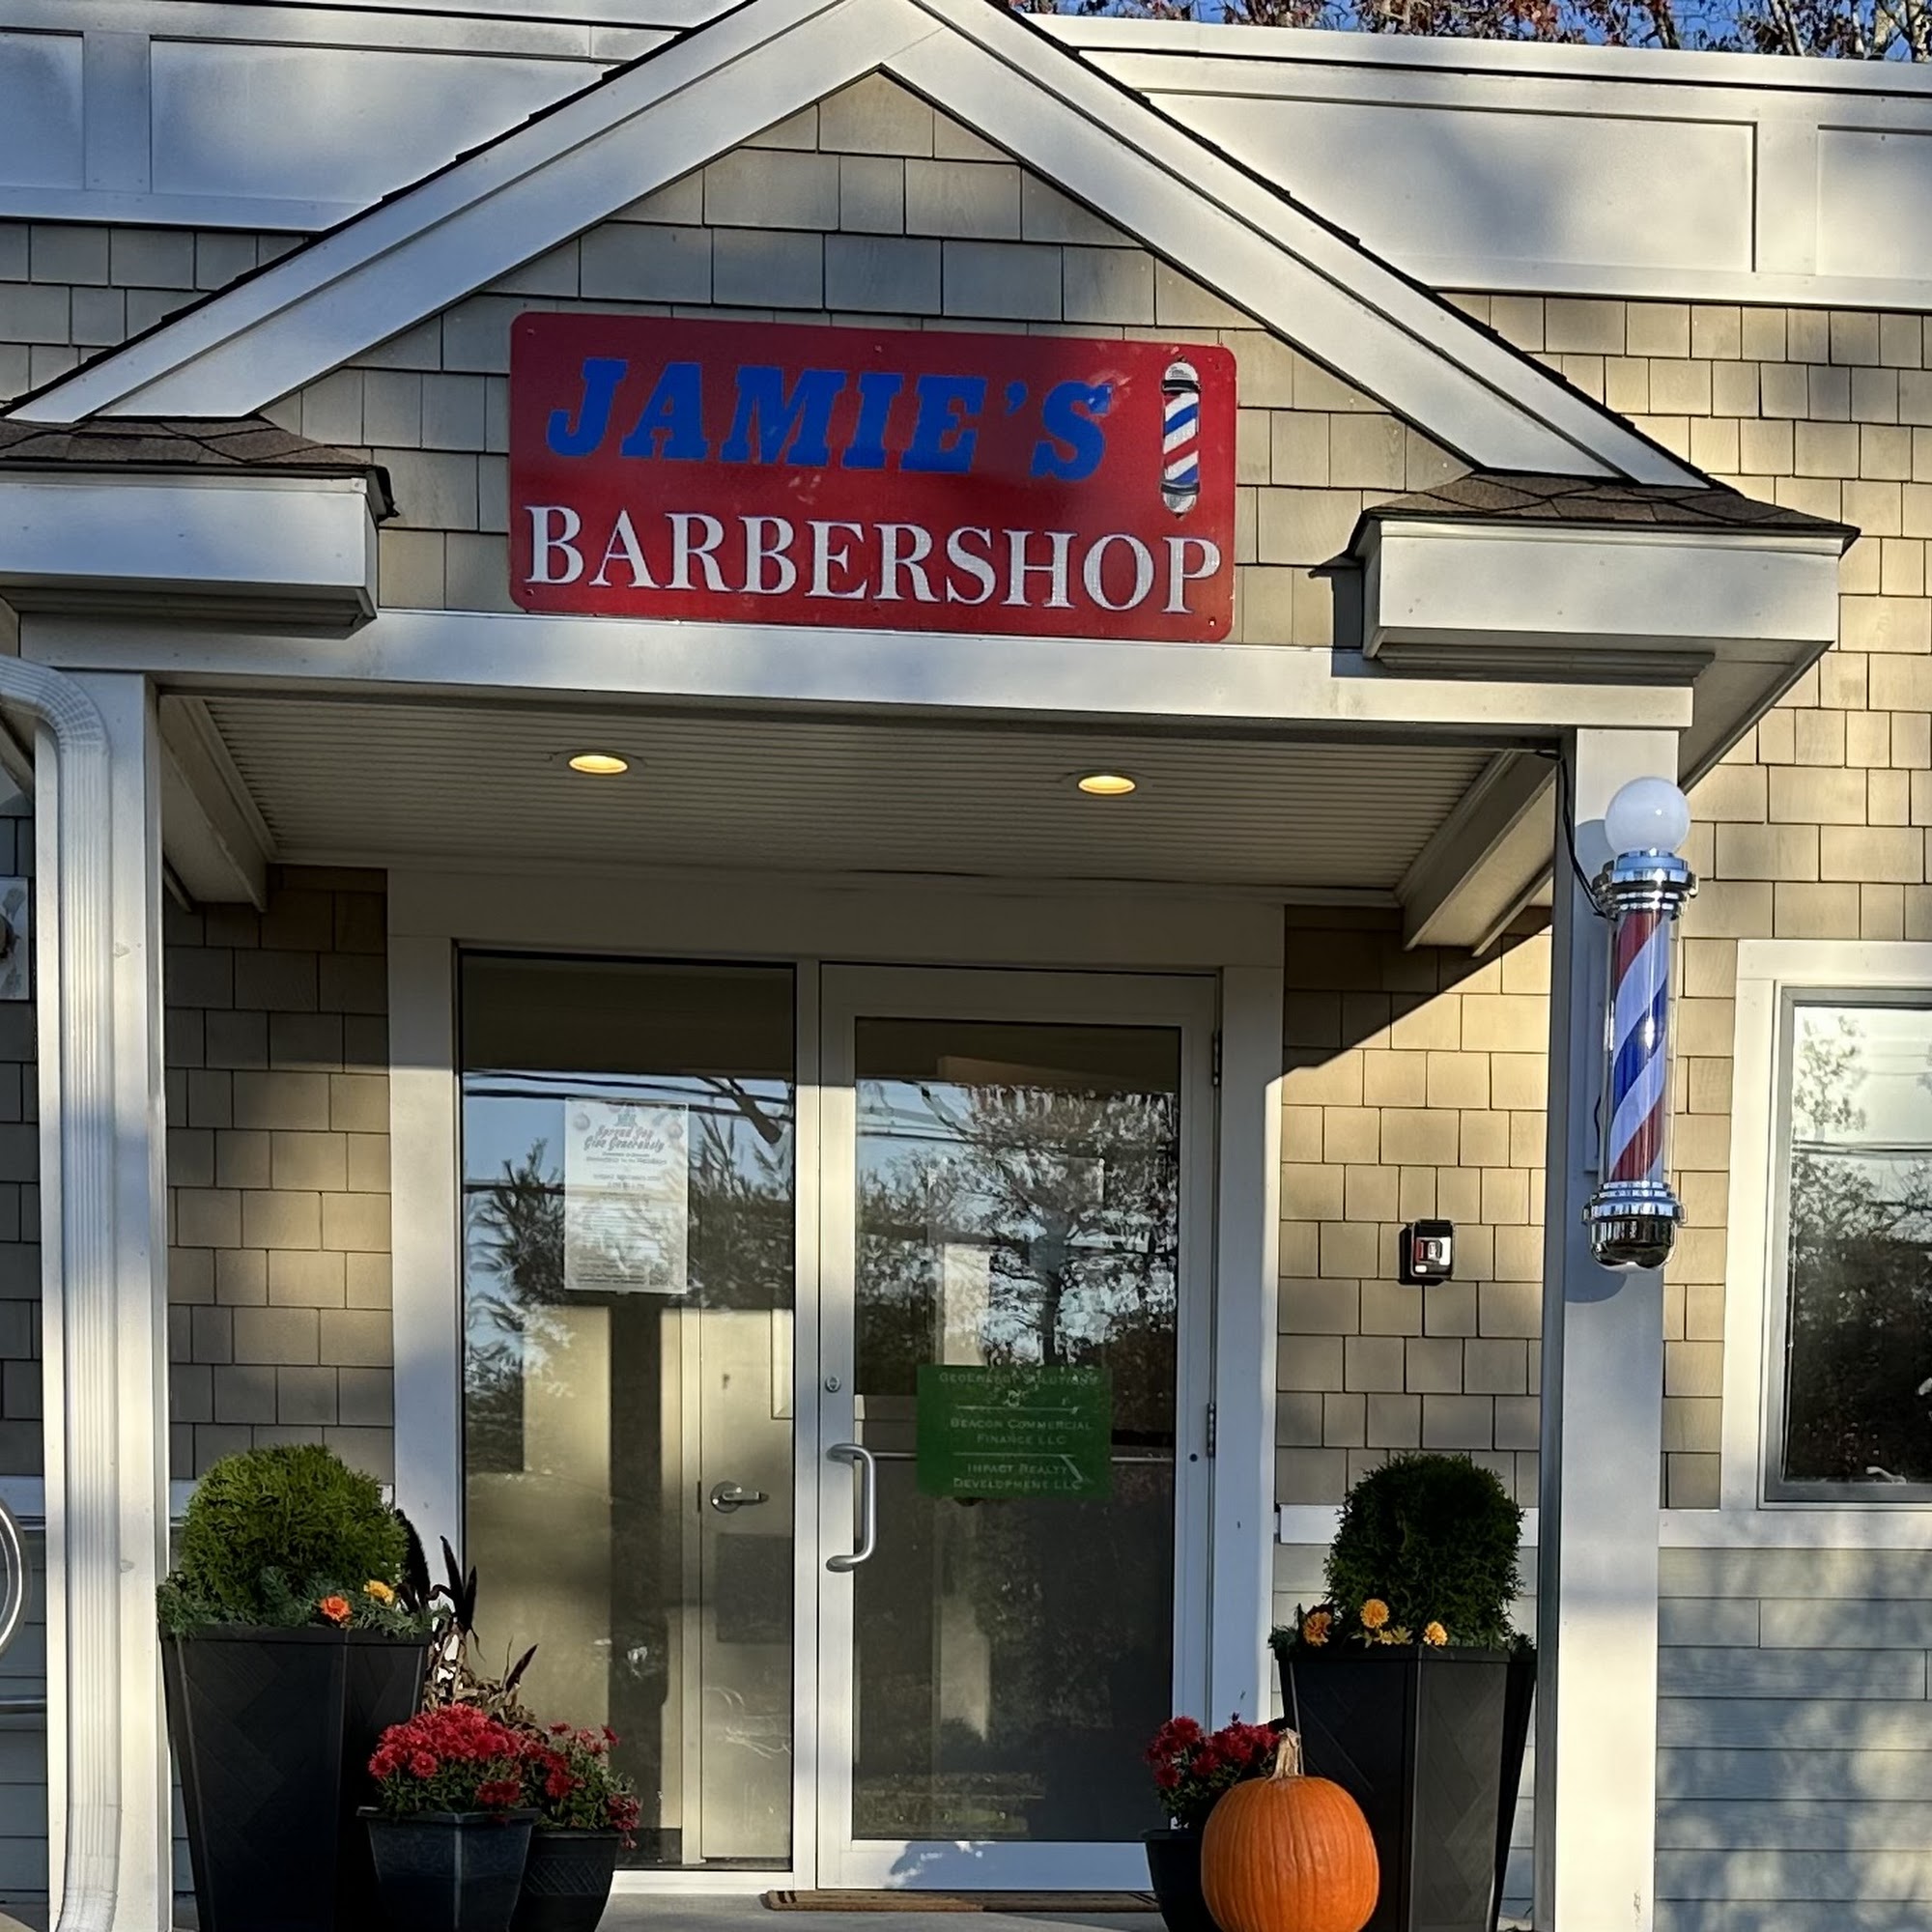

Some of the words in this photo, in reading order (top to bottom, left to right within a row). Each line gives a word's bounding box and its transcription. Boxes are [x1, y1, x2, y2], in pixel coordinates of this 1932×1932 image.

[547, 358, 1113, 481] JAMIE'S
[525, 505, 1221, 614] BARBERSHOP
[1023, 1374, 1099, 1385] SLUTINS
[950, 1417, 1003, 1429] BEACON
[1008, 1418, 1093, 1430] COMMERCIAL
[977, 1434, 1033, 1445] FINANCE
[1037, 1435, 1067, 1445] LLC
[952, 1477, 1049, 1490] DEVELOPMENT
